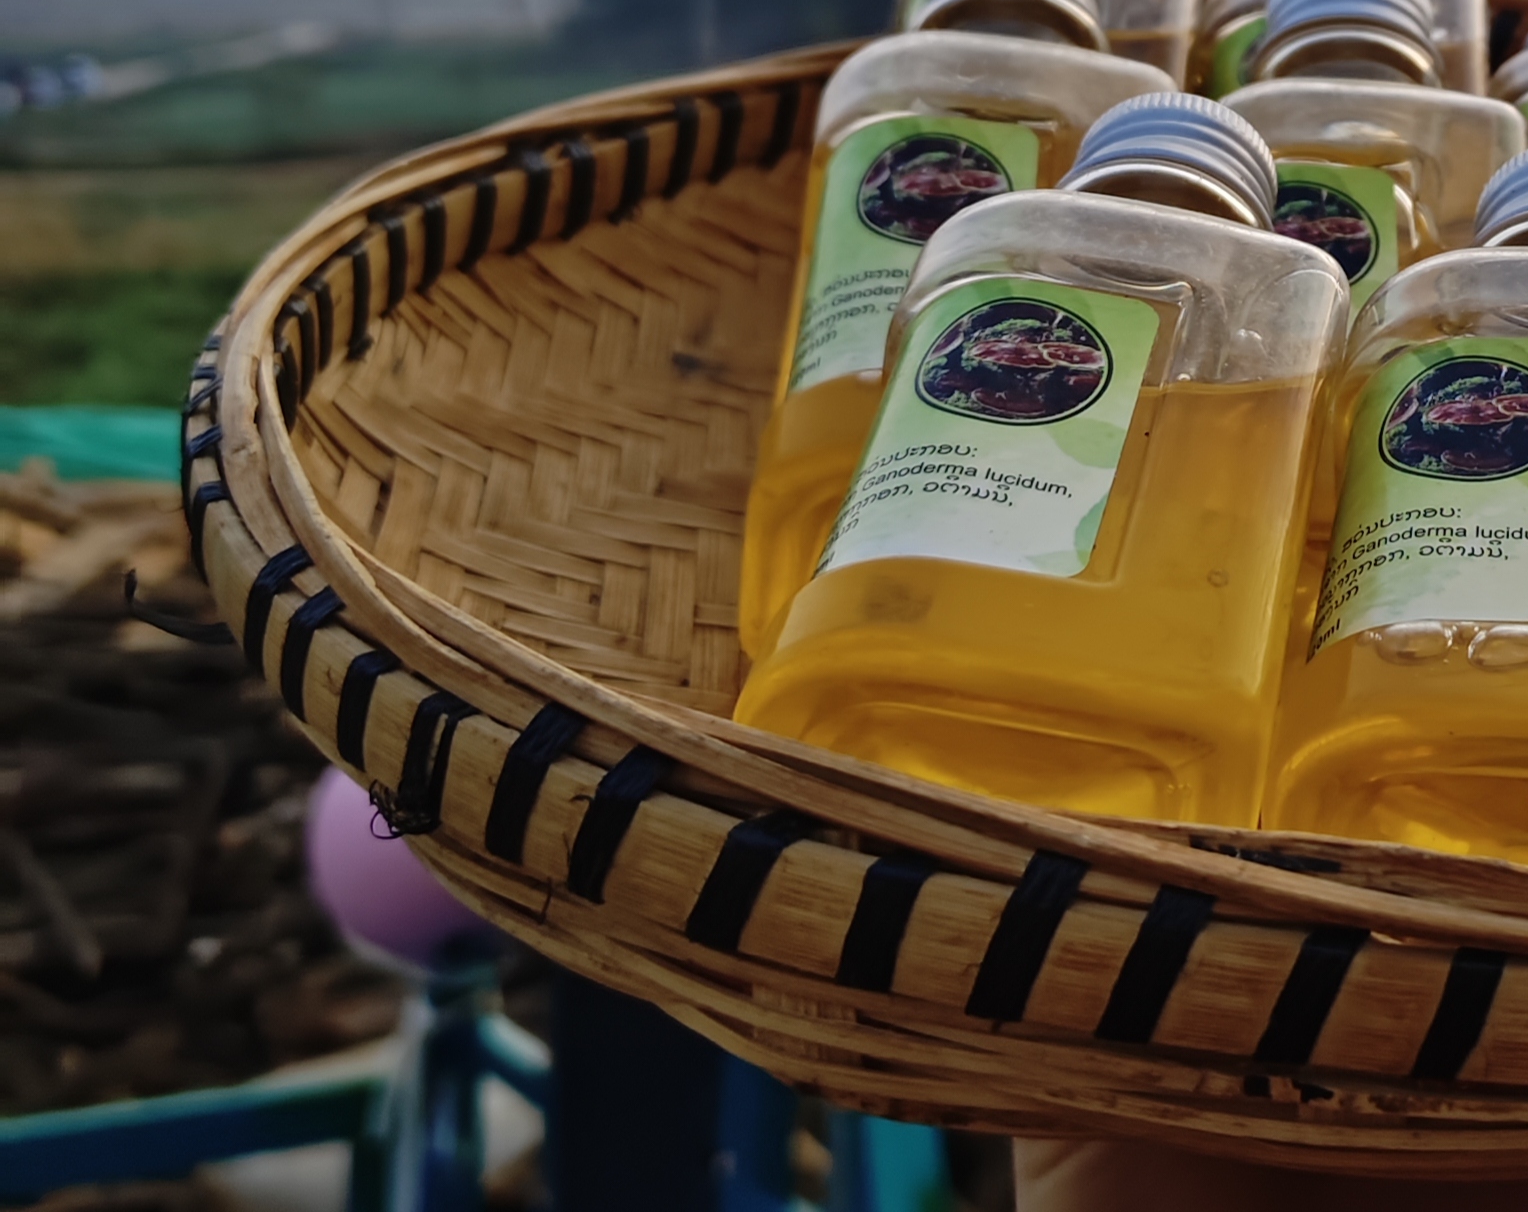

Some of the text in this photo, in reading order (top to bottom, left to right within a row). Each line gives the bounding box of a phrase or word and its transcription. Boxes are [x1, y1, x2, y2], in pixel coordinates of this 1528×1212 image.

[862, 461, 1073, 499] Ganoderma lucidum,
[1352, 526, 1467, 561] Ganoderma
